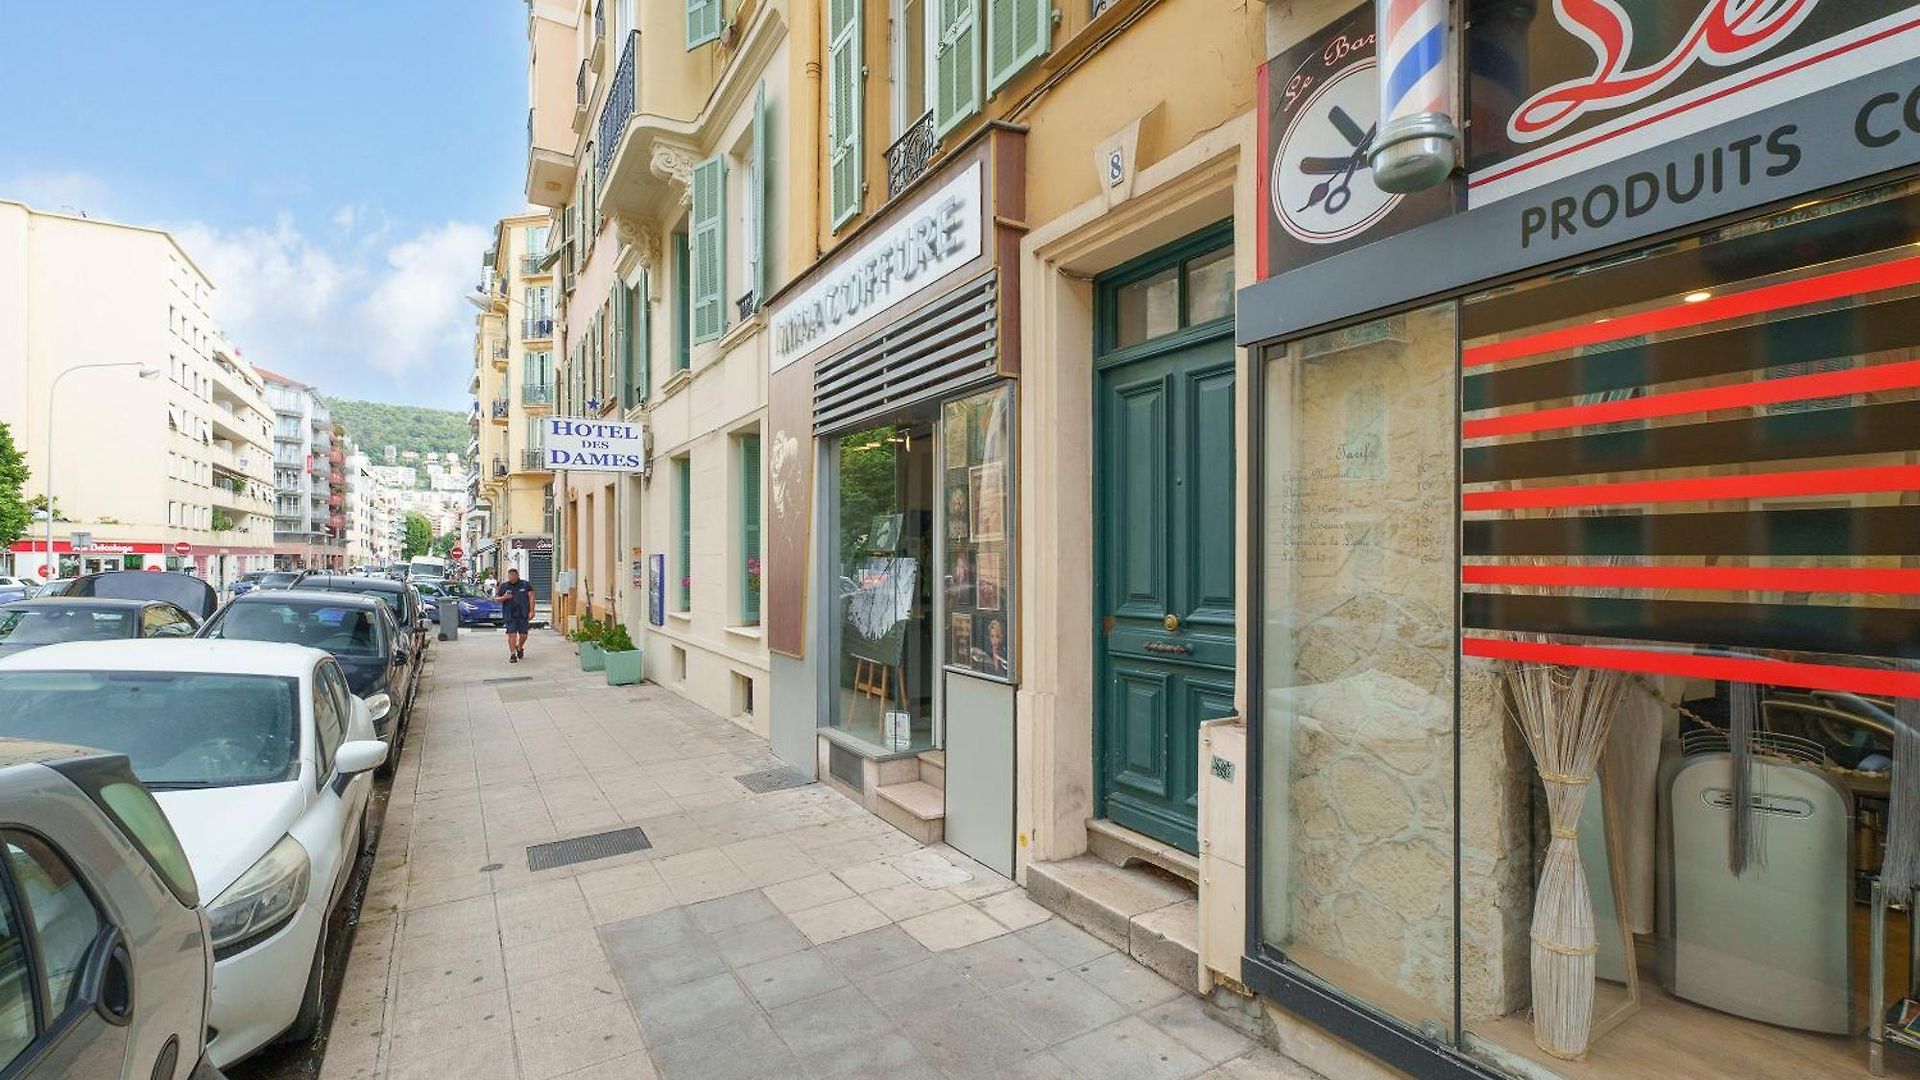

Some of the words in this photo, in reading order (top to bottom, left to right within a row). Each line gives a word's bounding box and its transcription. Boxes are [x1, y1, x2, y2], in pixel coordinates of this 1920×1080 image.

[1324, 35, 1377, 66] Bar
[1110, 153, 1121, 180] 8
[1521, 124, 1801, 249] PRODUITS
[551, 420, 638, 440] HOTEL
[581, 440, 609, 449] DES
[550, 449, 640, 468] DAMES
